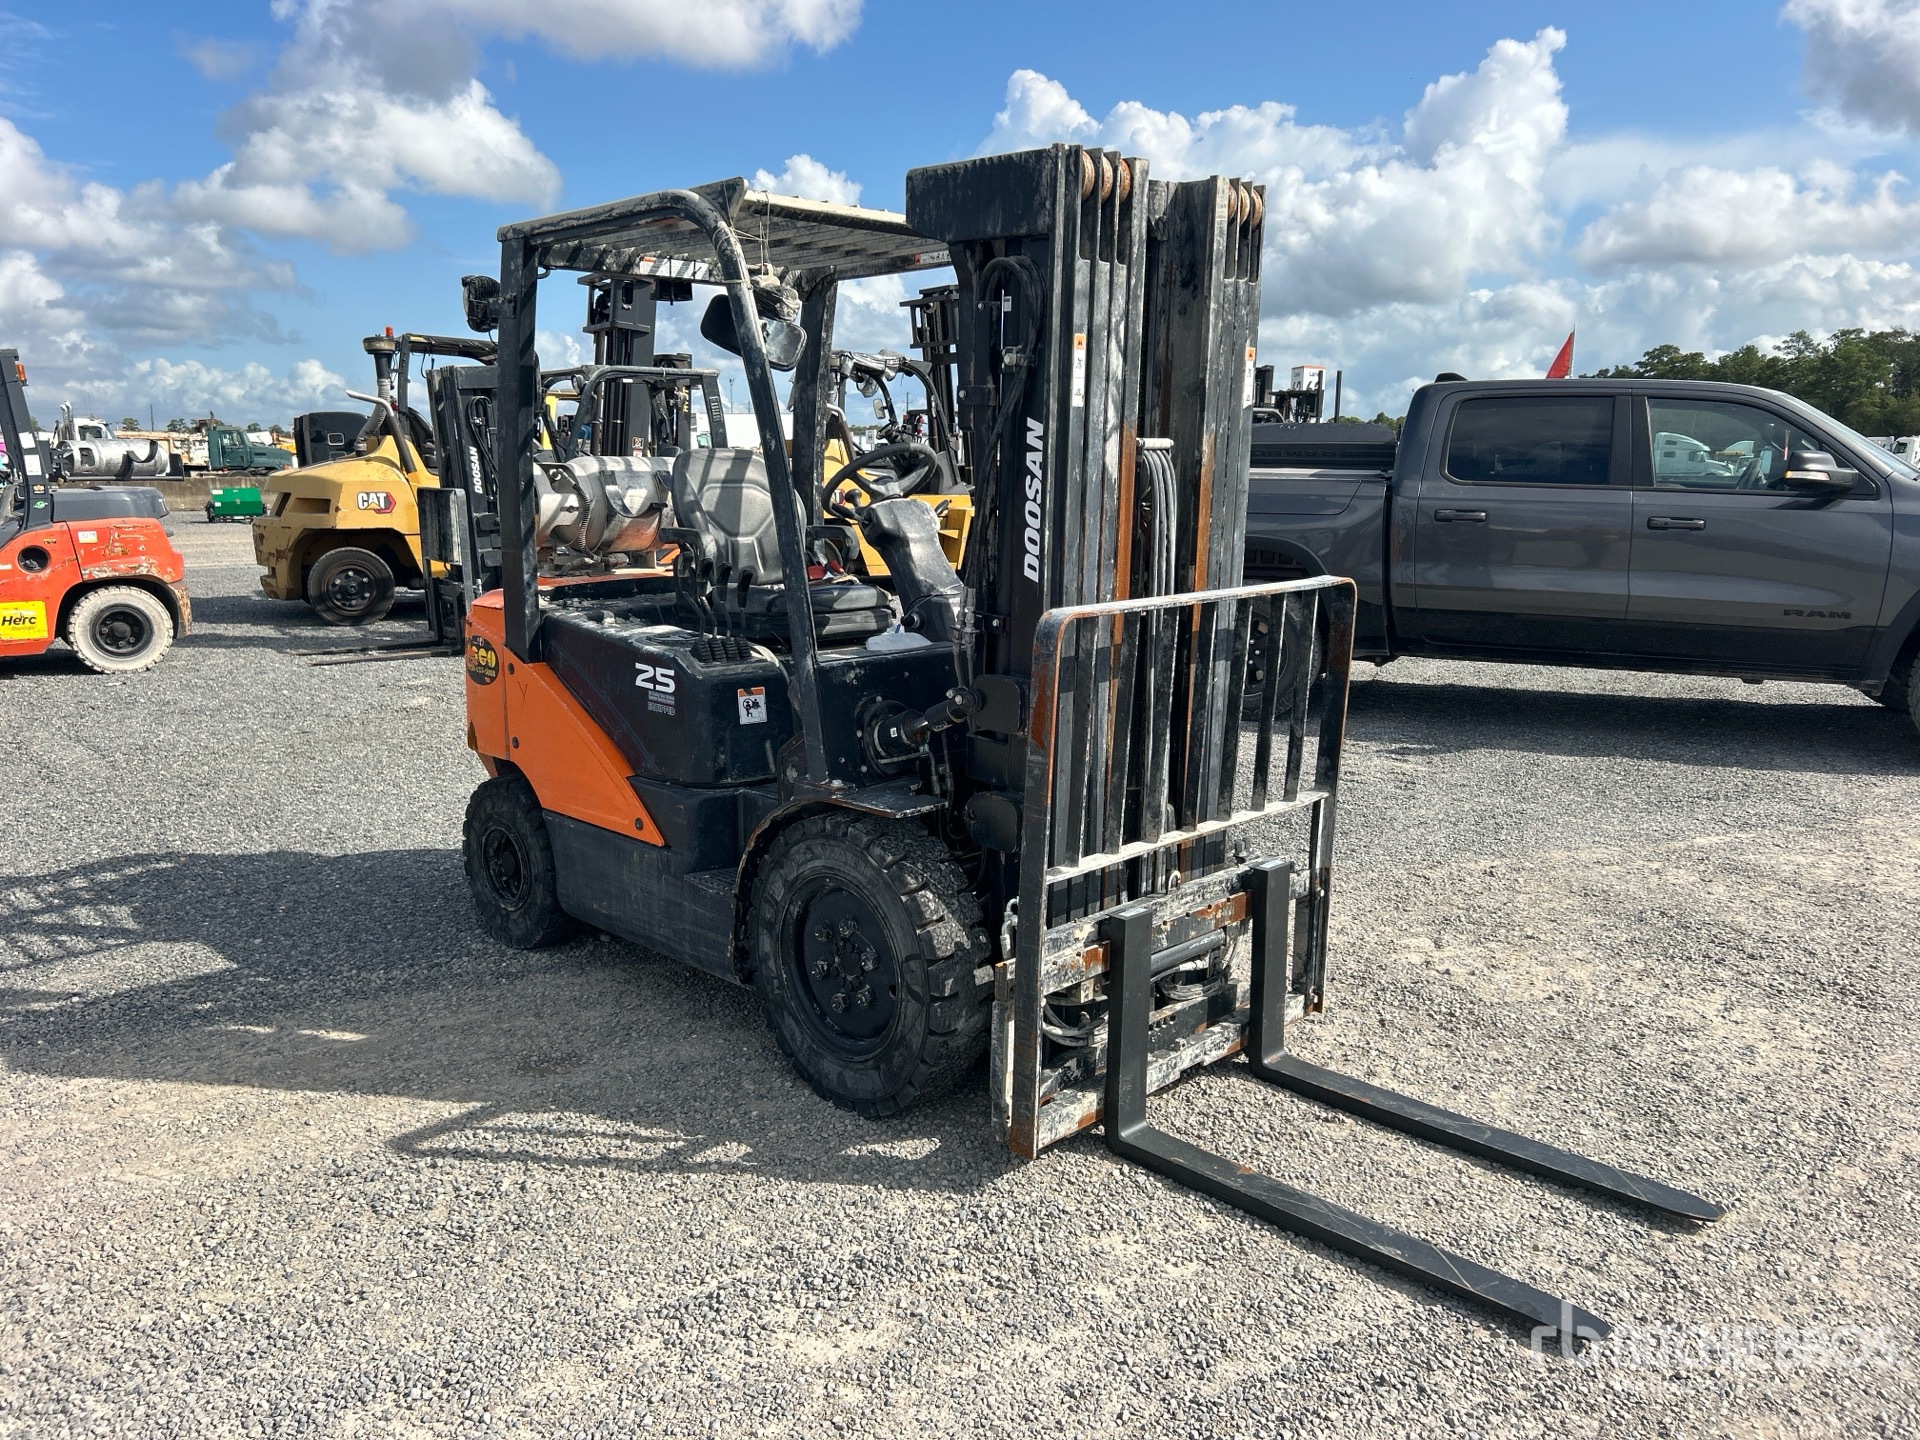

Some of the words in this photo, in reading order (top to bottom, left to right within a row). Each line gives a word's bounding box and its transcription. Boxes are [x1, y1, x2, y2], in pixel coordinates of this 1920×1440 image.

[469, 445, 483, 494] DOOSAN
[357, 492, 388, 510] CAT
[1024, 416, 1044, 583] DOOSAN
[1, 615, 37, 626] Herc
[1783, 609, 1852, 619] RAM
[635, 662, 676, 694] 25
